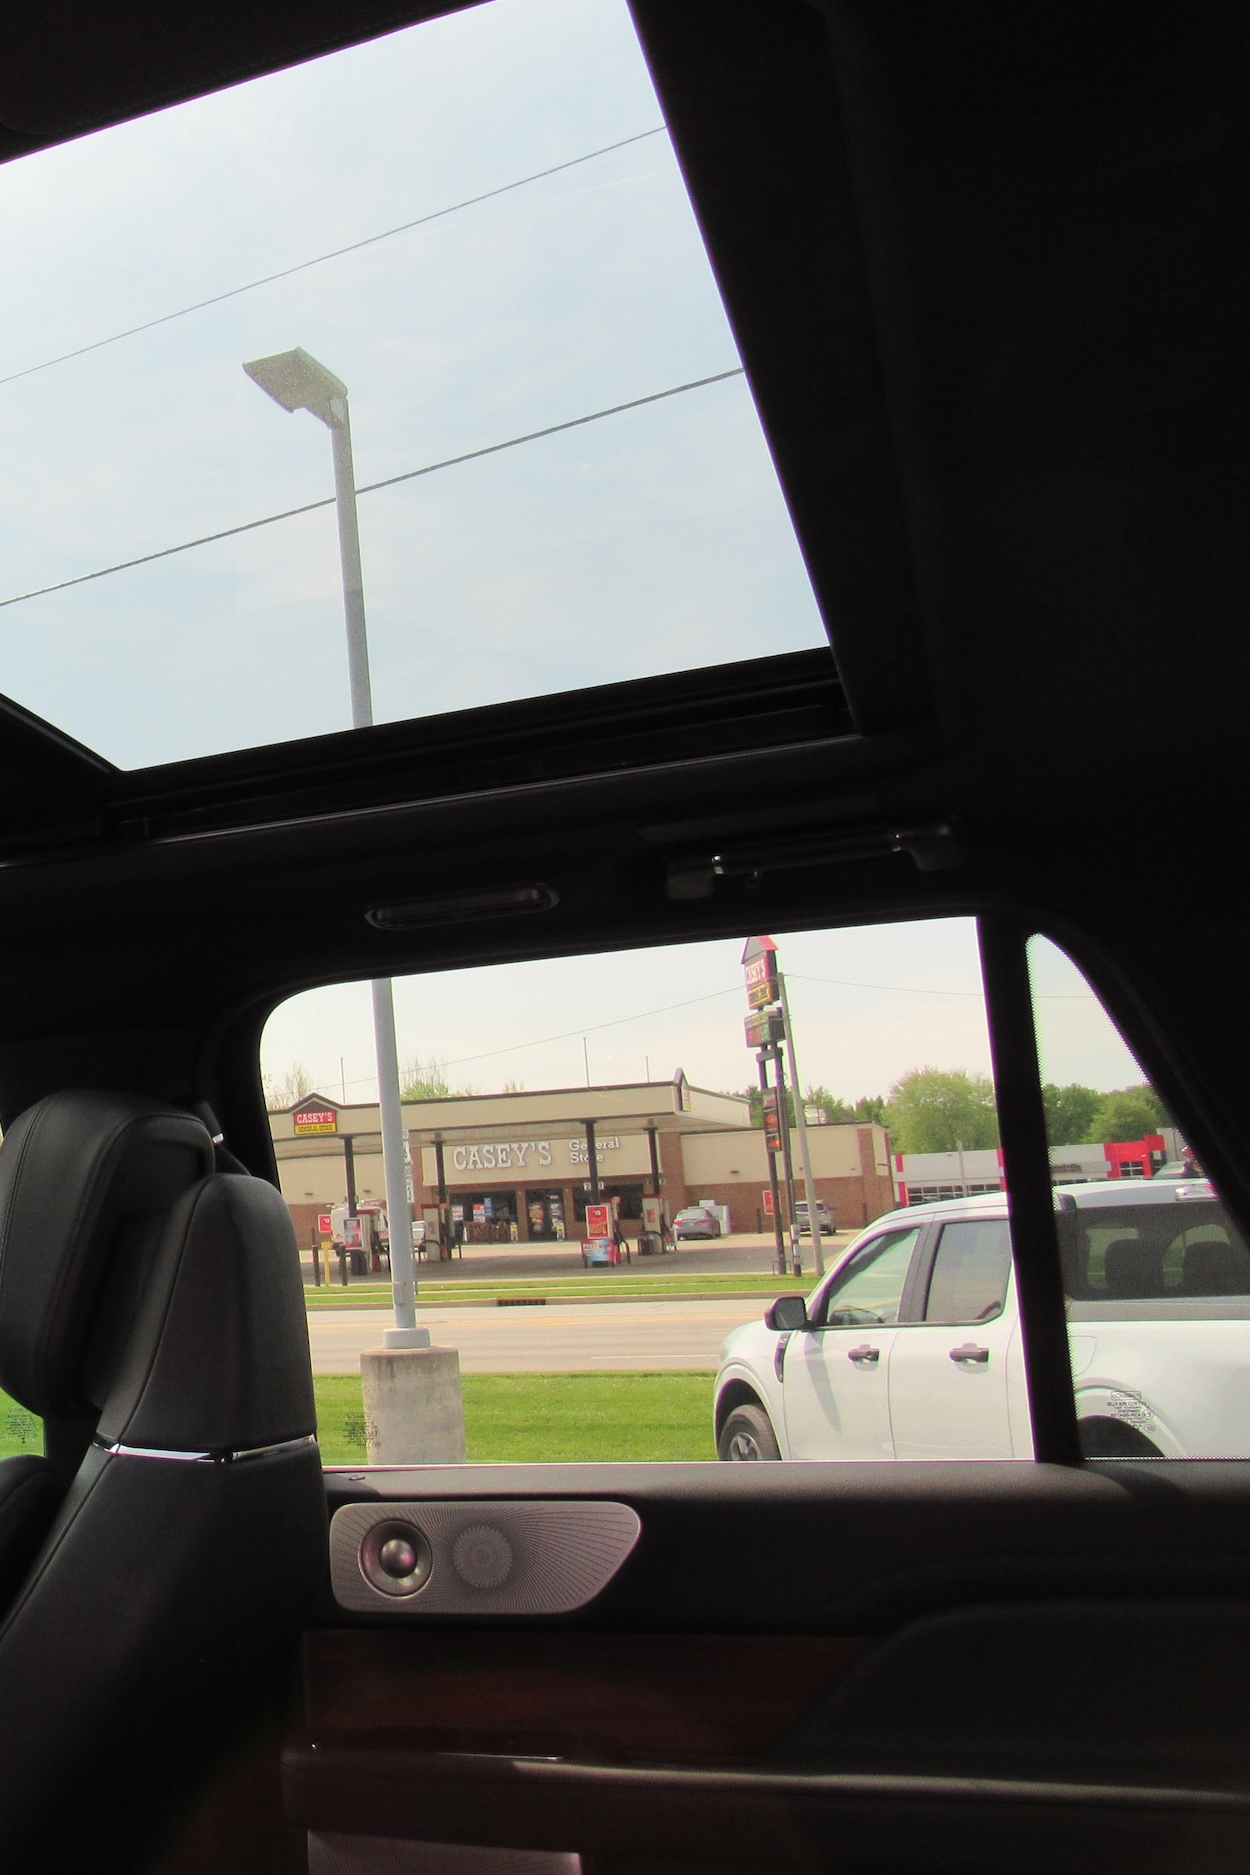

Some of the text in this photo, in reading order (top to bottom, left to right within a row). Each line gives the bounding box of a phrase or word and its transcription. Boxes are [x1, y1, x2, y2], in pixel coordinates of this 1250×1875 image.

[296, 1112, 333, 1124] CASEY'S
[568, 1137, 620, 1152] Geeral
[453, 1141, 552, 1171] CASEY'S
[570, 1151, 604, 1165] Stoe
